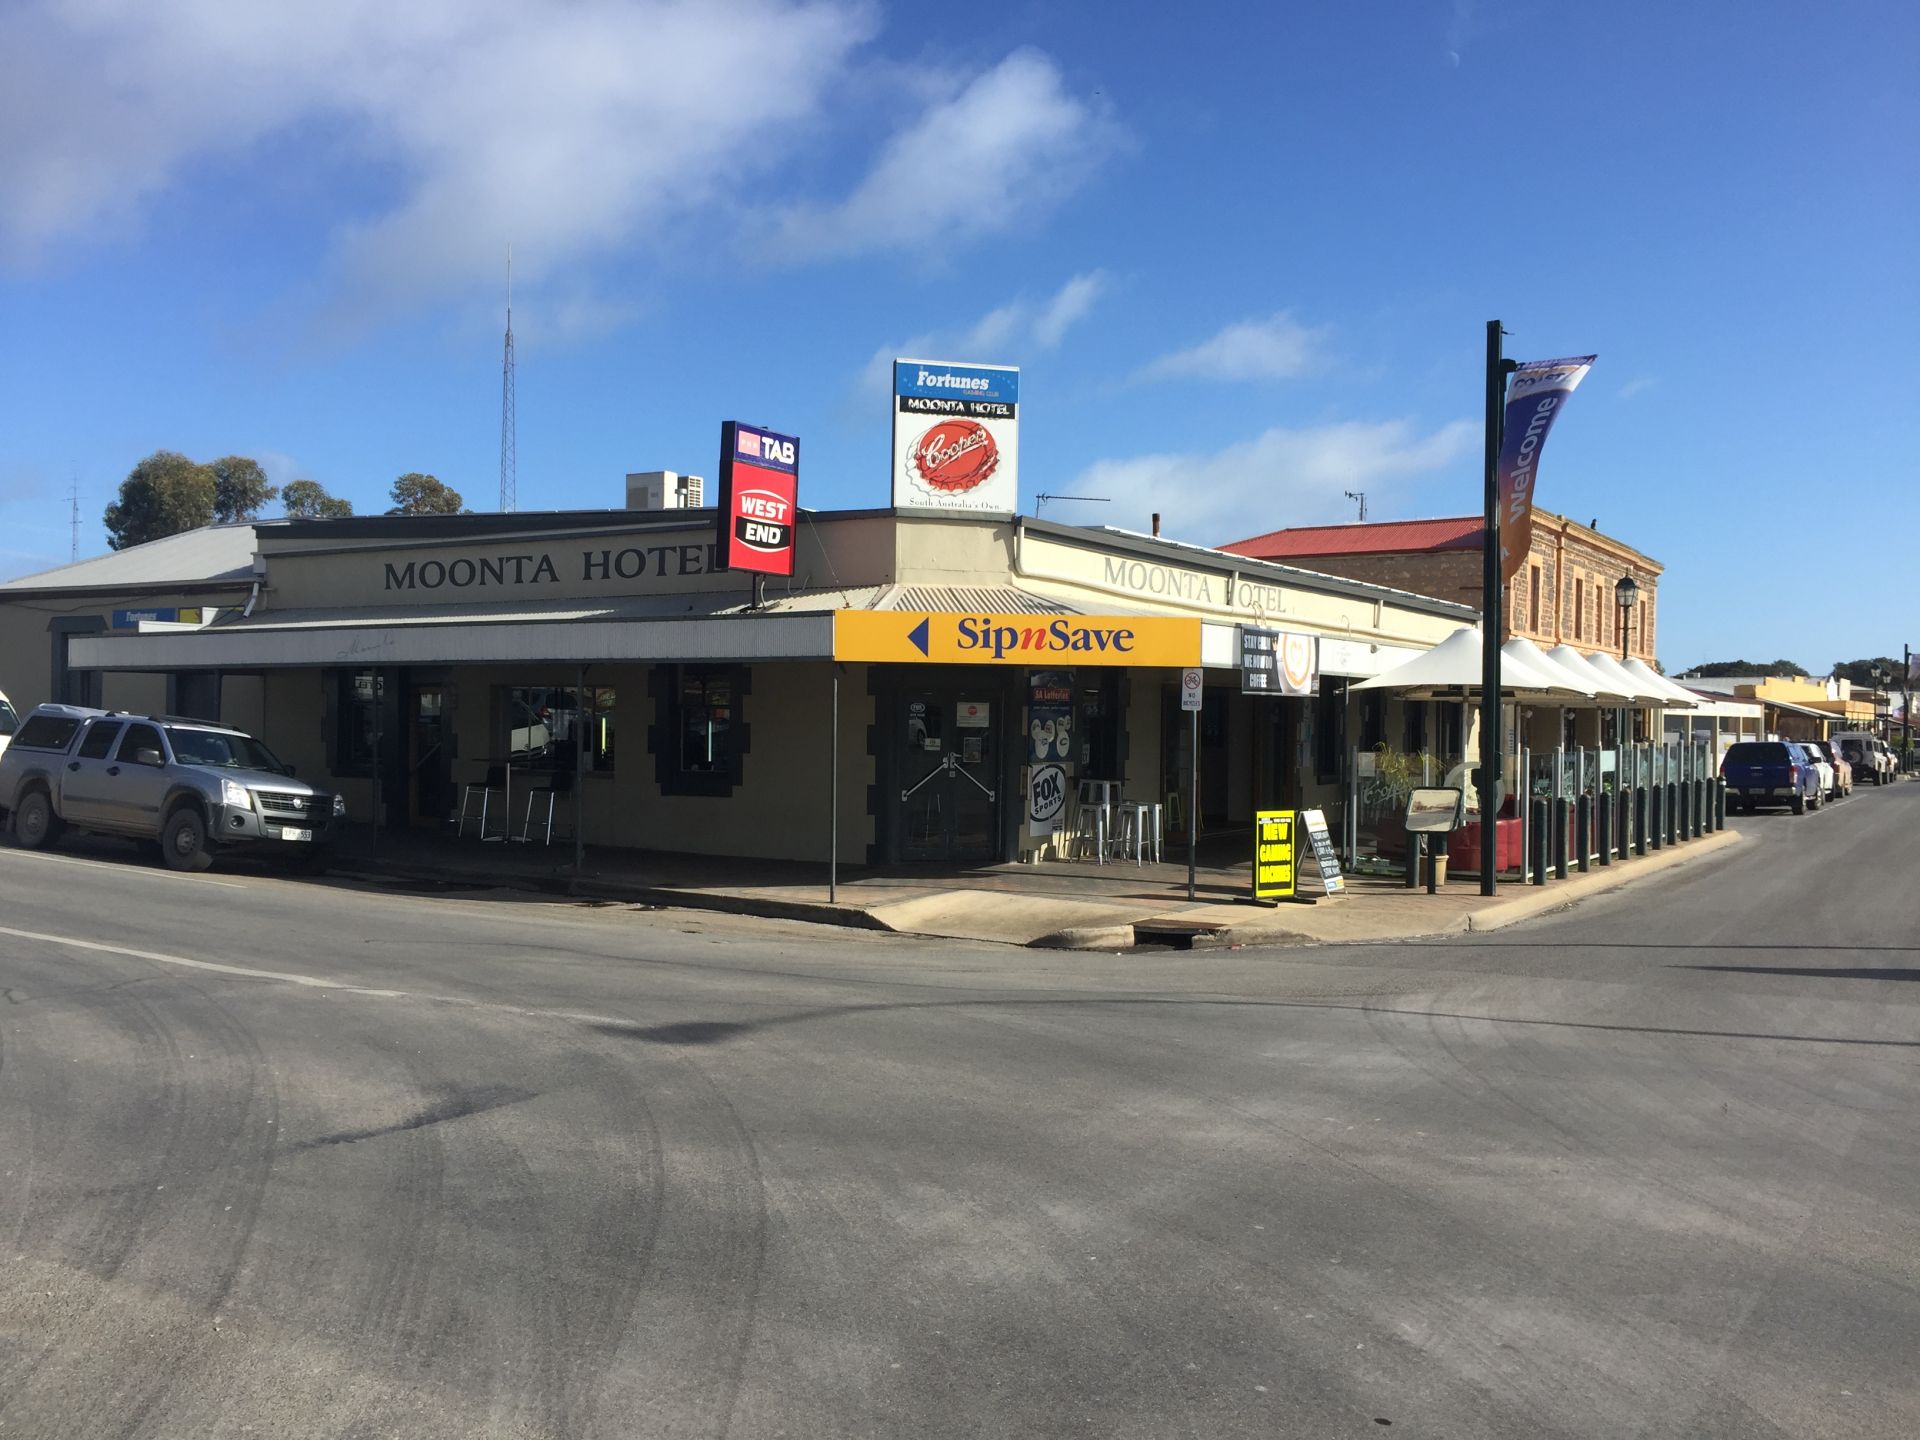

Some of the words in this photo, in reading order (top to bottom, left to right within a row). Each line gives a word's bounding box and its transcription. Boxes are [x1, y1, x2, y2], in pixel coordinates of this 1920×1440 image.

[917, 370, 990, 391] Fortunes
[908, 398, 965, 412] MOONTA
[971, 402, 1010, 415] HOTEL
[762, 436, 795, 465] TAB
[741, 495, 787, 520] WEST
[909, 498, 933, 507] South
[936, 499, 978, 509] Australia's
[745, 522, 781, 544] END
[384, 553, 560, 590] MOONTA
[582, 543, 730, 581] HOTEL
[1104, 556, 1212, 603] MOONTA
[1244, 634, 1257, 649] STAY
[1258, 636, 1271, 651] CALM
[1244, 654, 1253, 668] WE
[1250, 674, 1267, 688] COFFEE
[1033, 771, 1061, 807] FOX
[1034, 795, 1062, 815] SPORTS
[1263, 822, 1288, 840] NEW
[1260, 843, 1291, 862] GAMING
[1260, 864, 1291, 883] MACHINES
